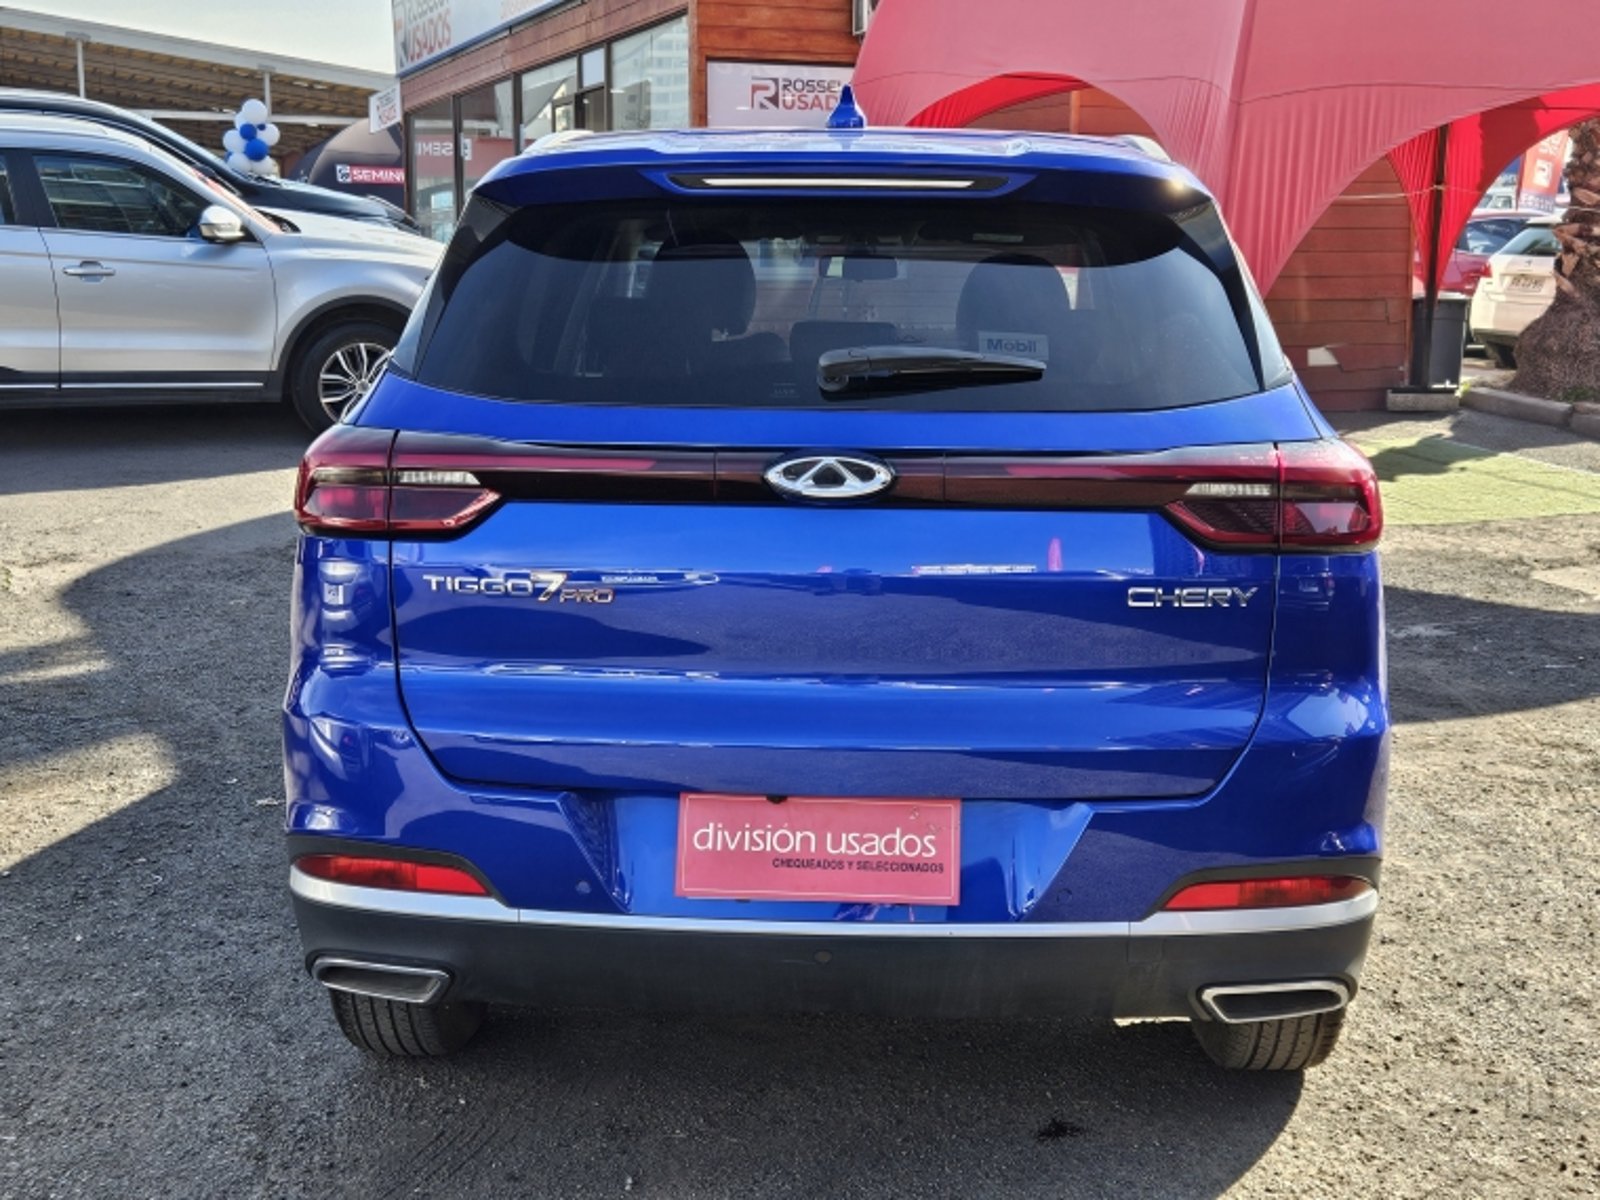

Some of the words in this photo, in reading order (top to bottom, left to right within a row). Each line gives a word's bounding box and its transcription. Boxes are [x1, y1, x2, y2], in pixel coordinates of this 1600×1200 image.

[781, 78, 842, 93] ROSSE
[986, 338, 1037, 353] Mobil
[559, 588, 615, 604] PRO
[1127, 586, 1260, 608] CHERY
[692, 821, 816, 852] división
[826, 827, 937, 858] usados
[772, 857, 845, 871] CHEQUEADOS
[846, 860, 854, 871] Y
[856, 860, 945, 874] SELECCIONADOS
